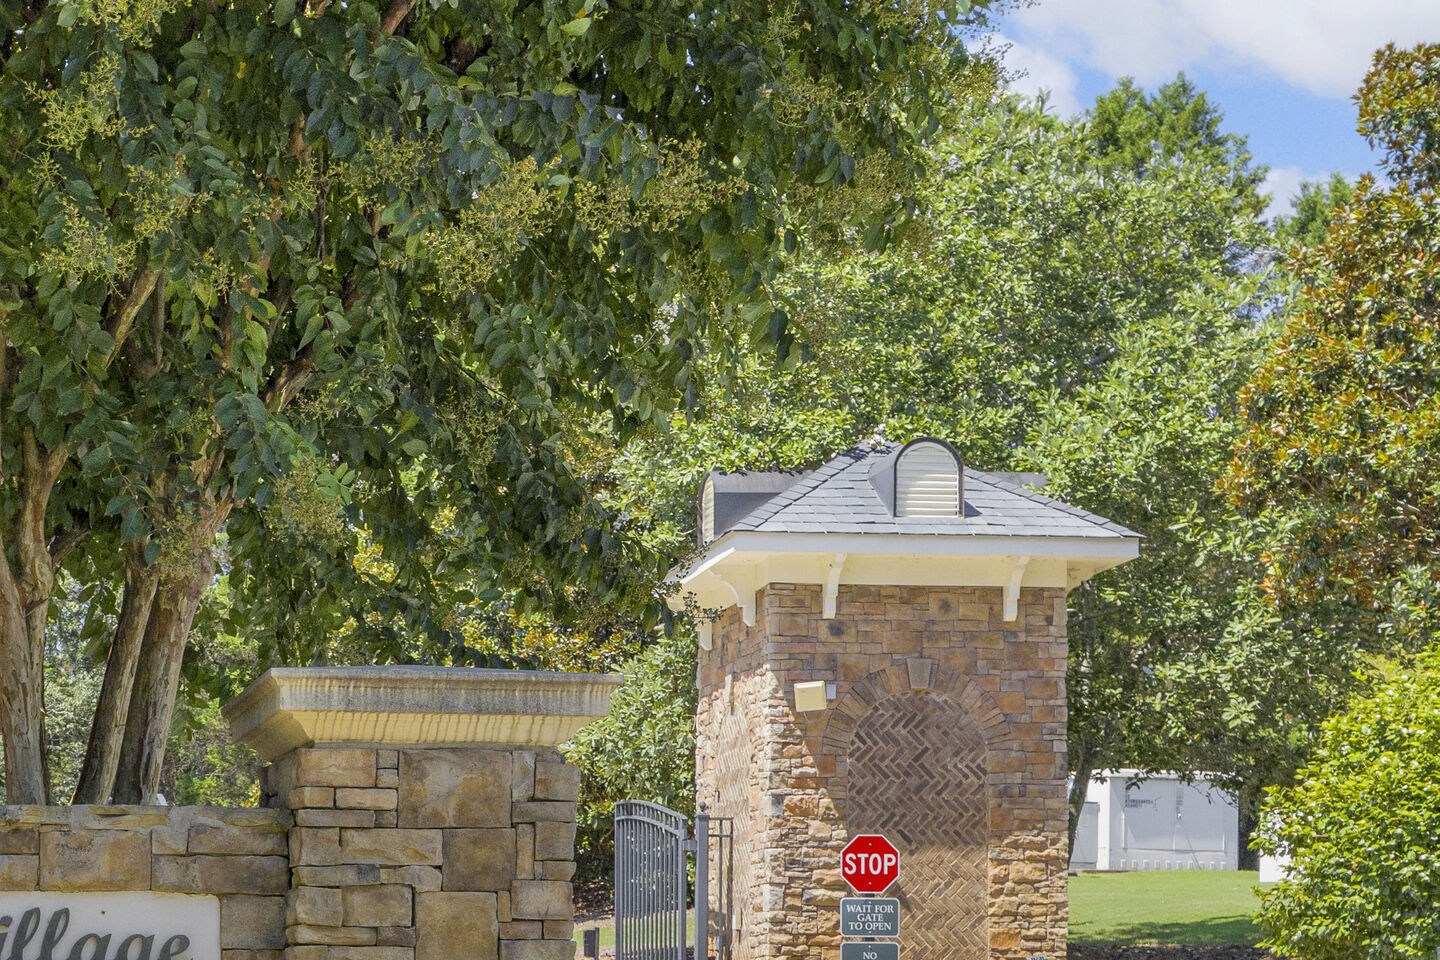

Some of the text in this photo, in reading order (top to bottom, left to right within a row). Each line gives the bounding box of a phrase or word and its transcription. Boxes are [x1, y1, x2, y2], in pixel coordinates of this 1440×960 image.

[844, 853, 896, 875] STOP
[846, 904, 894, 913] WAIT FOR
[856, 913, 884, 922] GATE
[848, 922, 892, 930] TO OPEN
[862, 952, 878, 960] NO
